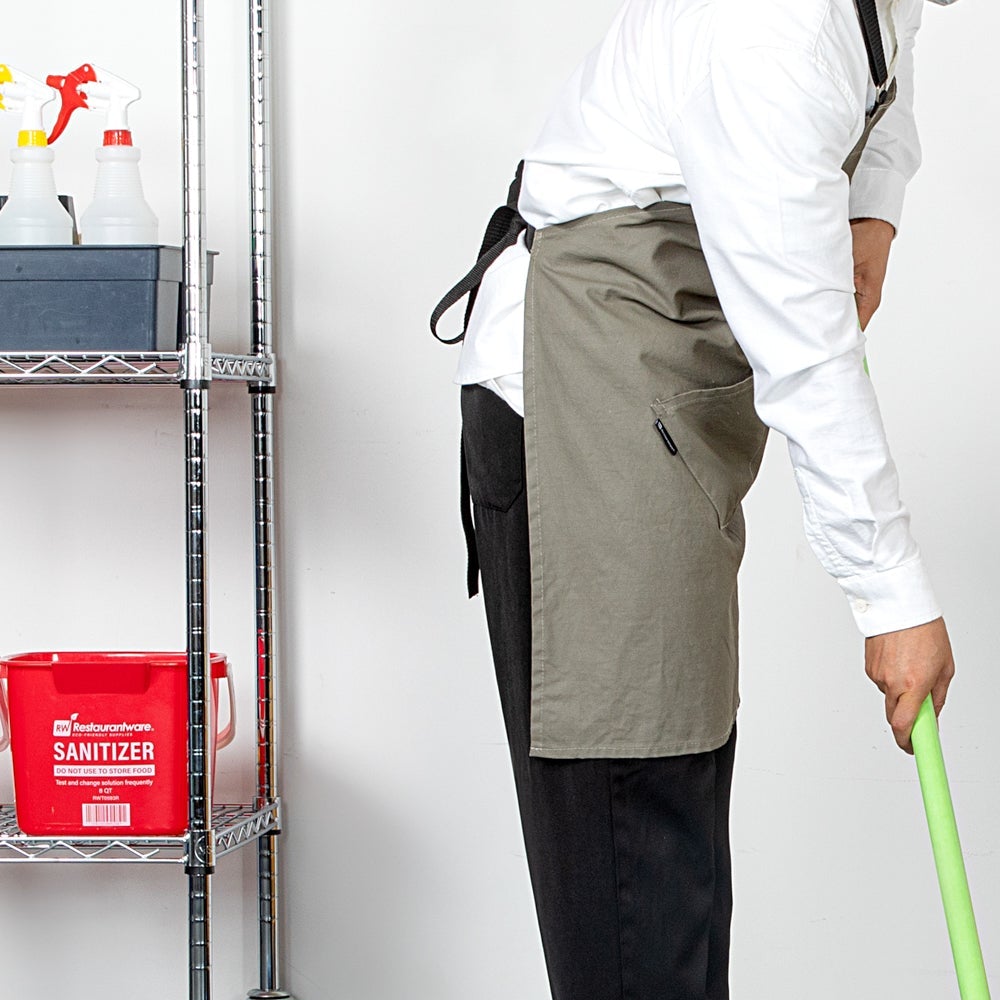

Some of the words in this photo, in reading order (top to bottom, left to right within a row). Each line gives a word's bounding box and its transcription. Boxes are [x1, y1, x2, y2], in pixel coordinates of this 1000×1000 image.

[56, 724, 71, 732] RW
[73, 722, 151, 732] Restaurantware
[53, 741, 155, 761] SANITIZER
[79, 779, 100, 787] change
[124, 779, 153, 787] frequently
